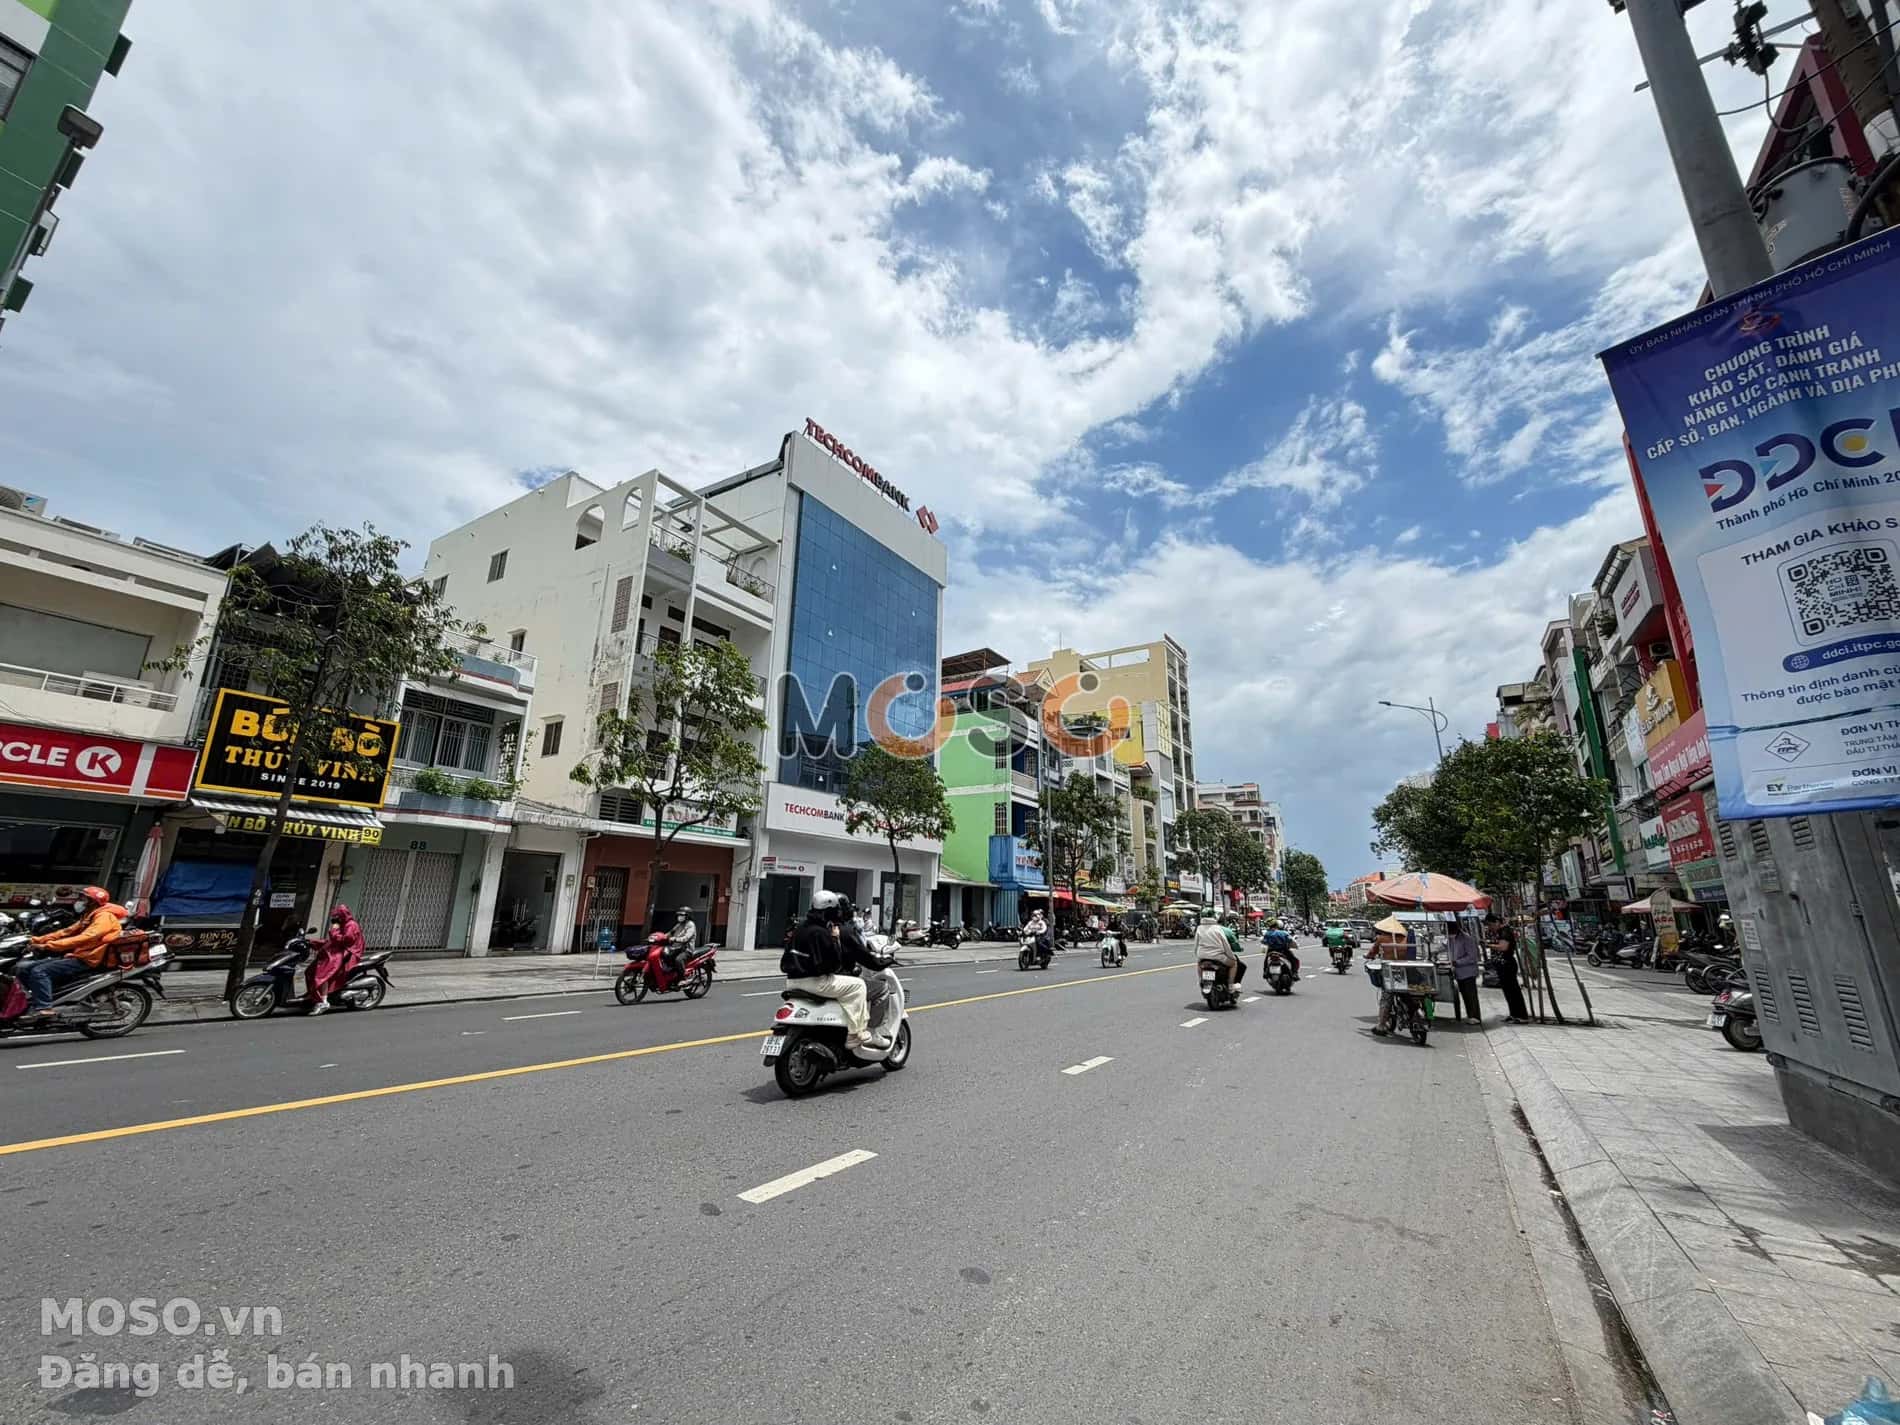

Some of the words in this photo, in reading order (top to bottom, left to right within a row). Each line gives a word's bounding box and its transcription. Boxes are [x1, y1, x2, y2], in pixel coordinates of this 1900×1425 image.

[1646, 333, 1668, 347] BAN
[1854, 241, 1891, 262] MINH
[1704, 340, 1772, 381] CHƯƠNG
[1775, 325, 1831, 349] TRÌNH
[1688, 380, 1734, 407] KHẢO
[1775, 347, 1823, 367] ĐÁNH
[1828, 330, 1863, 355] GIÁ
[1683, 401, 1728, 427] NĂNG
[1731, 384, 1761, 408] LỰC
[1765, 368, 1811, 390] CẠNH
[1815, 349, 1881, 378] TRANH
[1647, 438, 1675, 459] CẤP
[1747, 388, 1802, 419] NGÀNH
[1805, 382, 1827, 397] VÀ
[1831, 374, 1864, 393] ĐỊA
[1869, 361, 1900, 383] PH
[805, 417, 910, 512] TECHCOMBANK
[1716, 508, 1759, 530] Thành
[1763, 493, 1786, 516] phố
[1788, 487, 1809, 503] Hồ
[1813, 478, 1841, 493] Chí
[1842, 475, 1880, 489] Minh
[1741, 541, 1791, 566] THAM
[1793, 529, 1824, 546] GIA
[1828, 517, 1881, 535] KHẢO
[1741, 688, 1785, 702] Thông
[1787, 684, 1806, 695] tin
[1809, 677, 1839, 690] định
[1842, 668, 1880, 682] danh
[1796, 691, 1832, 705] được
[1834, 686, 1860, 698] bảo
[1863, 679, 1896, 691] mật
[1840, 724, 1868, 736] ĐƠN
[1869, 721, 1884, 731] VỊ
[1843, 737, 1874, 747] TRUNG
[0, 740, 70, 767] CLE
[225, 745, 302, 771] THÚ
[317, 759, 376, 783] VIN
[260, 772, 310, 786] SINE
[311, 779, 341, 790] 2019
[1852, 767, 1881, 777] ĐƠN
[1767, 784, 1783, 792] EY
[784, 803, 845, 822] TECHCOMBANK
[271, 820, 318, 836] HÚY
[320, 827, 361, 841] VINH
[363, 829, 379, 839] 90
[410, 840, 427, 850] 88
